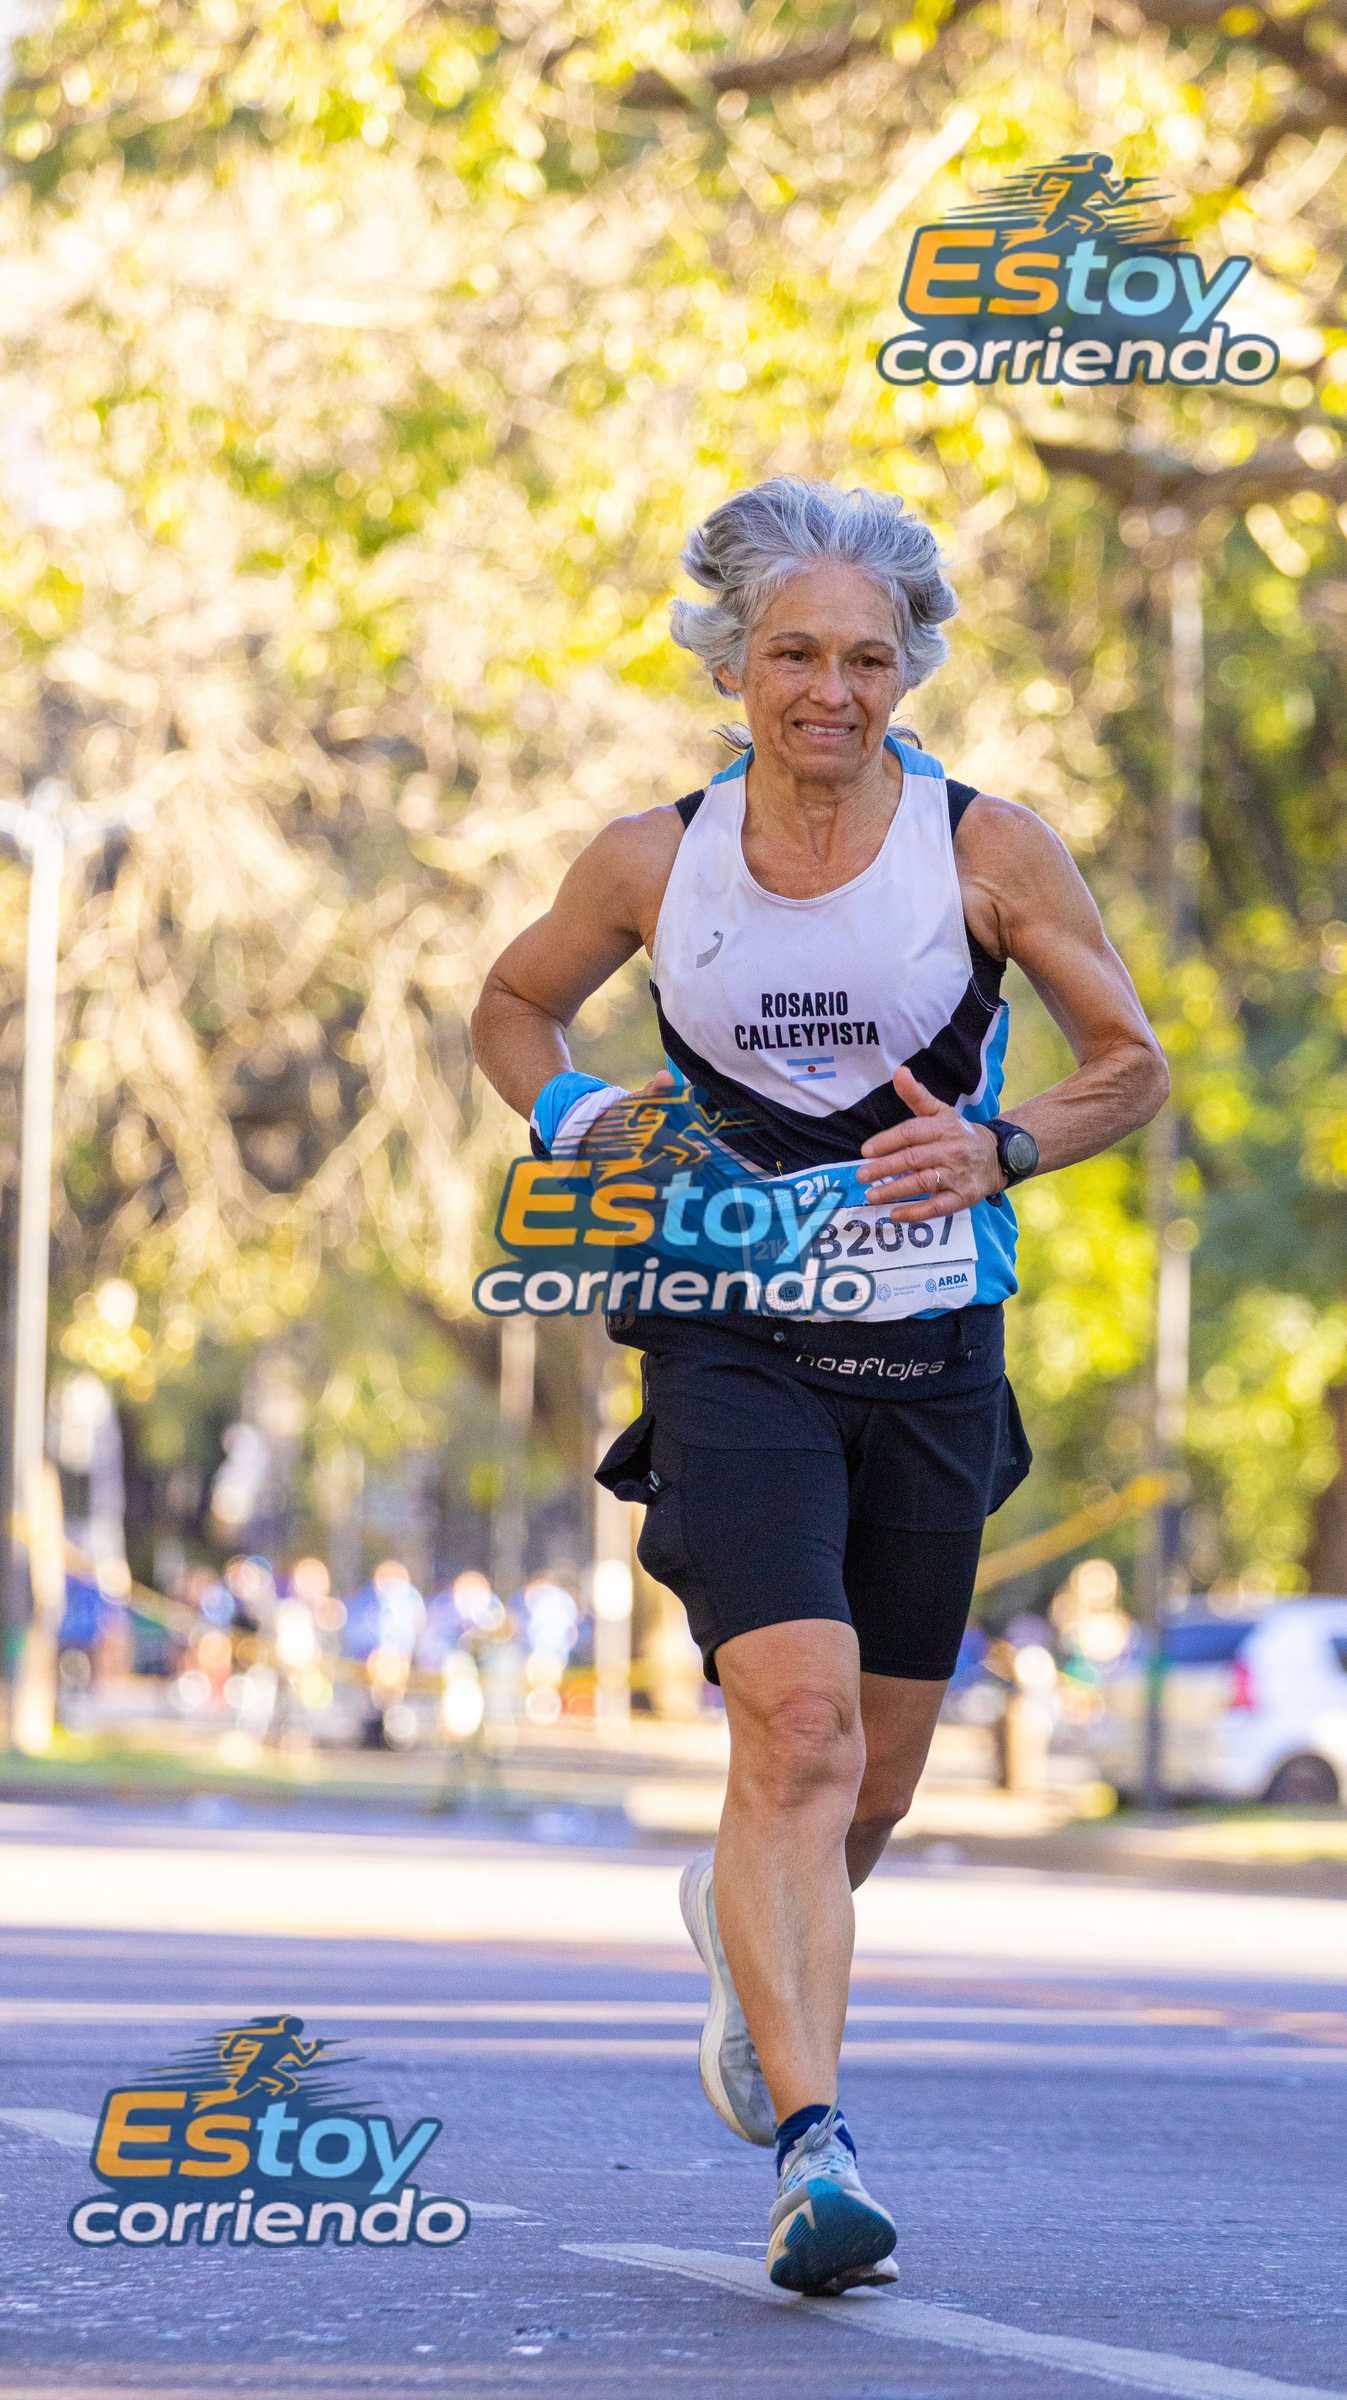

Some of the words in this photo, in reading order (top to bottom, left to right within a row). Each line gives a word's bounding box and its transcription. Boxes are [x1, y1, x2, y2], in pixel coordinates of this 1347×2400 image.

[761, 990, 849, 1019] ROSARIO
[734, 1021, 880, 1051] CALLEYPISTA
[938, 1272, 968, 1288] ARDA
